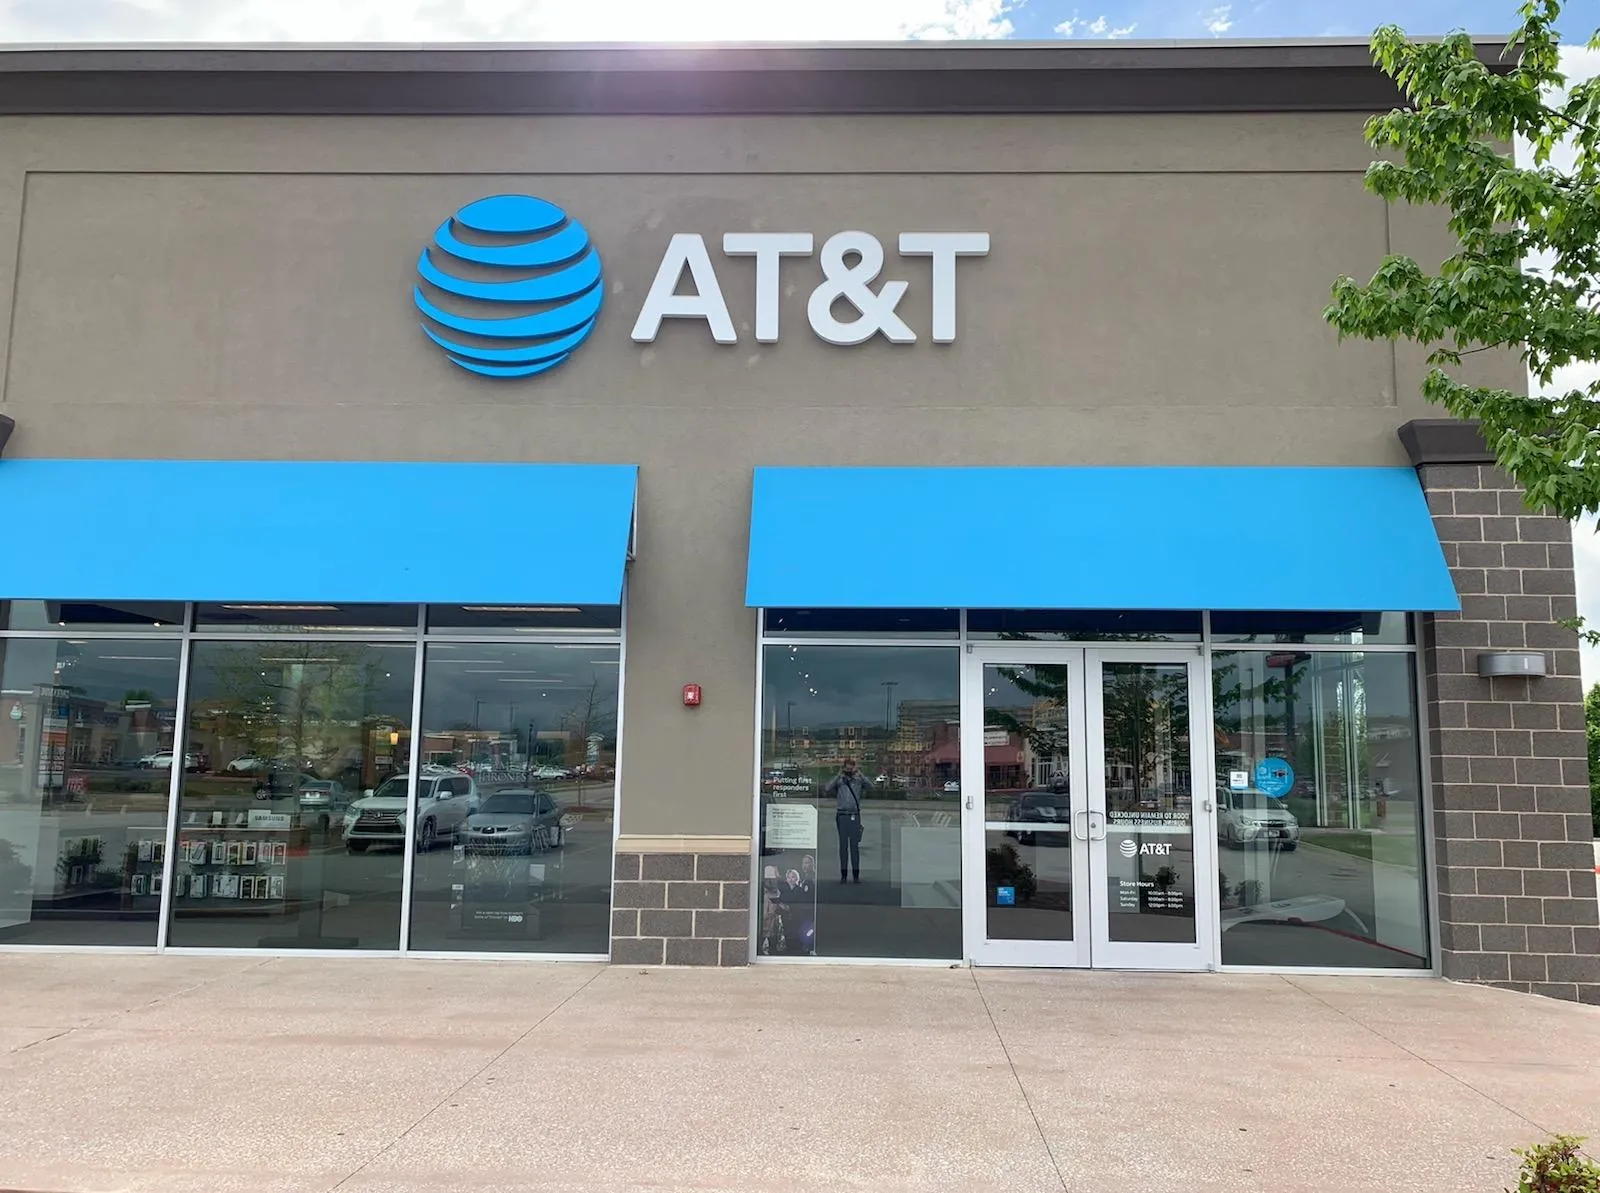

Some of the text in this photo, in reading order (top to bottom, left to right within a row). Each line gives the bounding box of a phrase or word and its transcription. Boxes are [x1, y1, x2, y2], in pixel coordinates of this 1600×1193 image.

[631, 230, 990, 346] AT&T
[1139, 843, 1172, 855] AT&T
[508, 915, 523, 923] HBO
